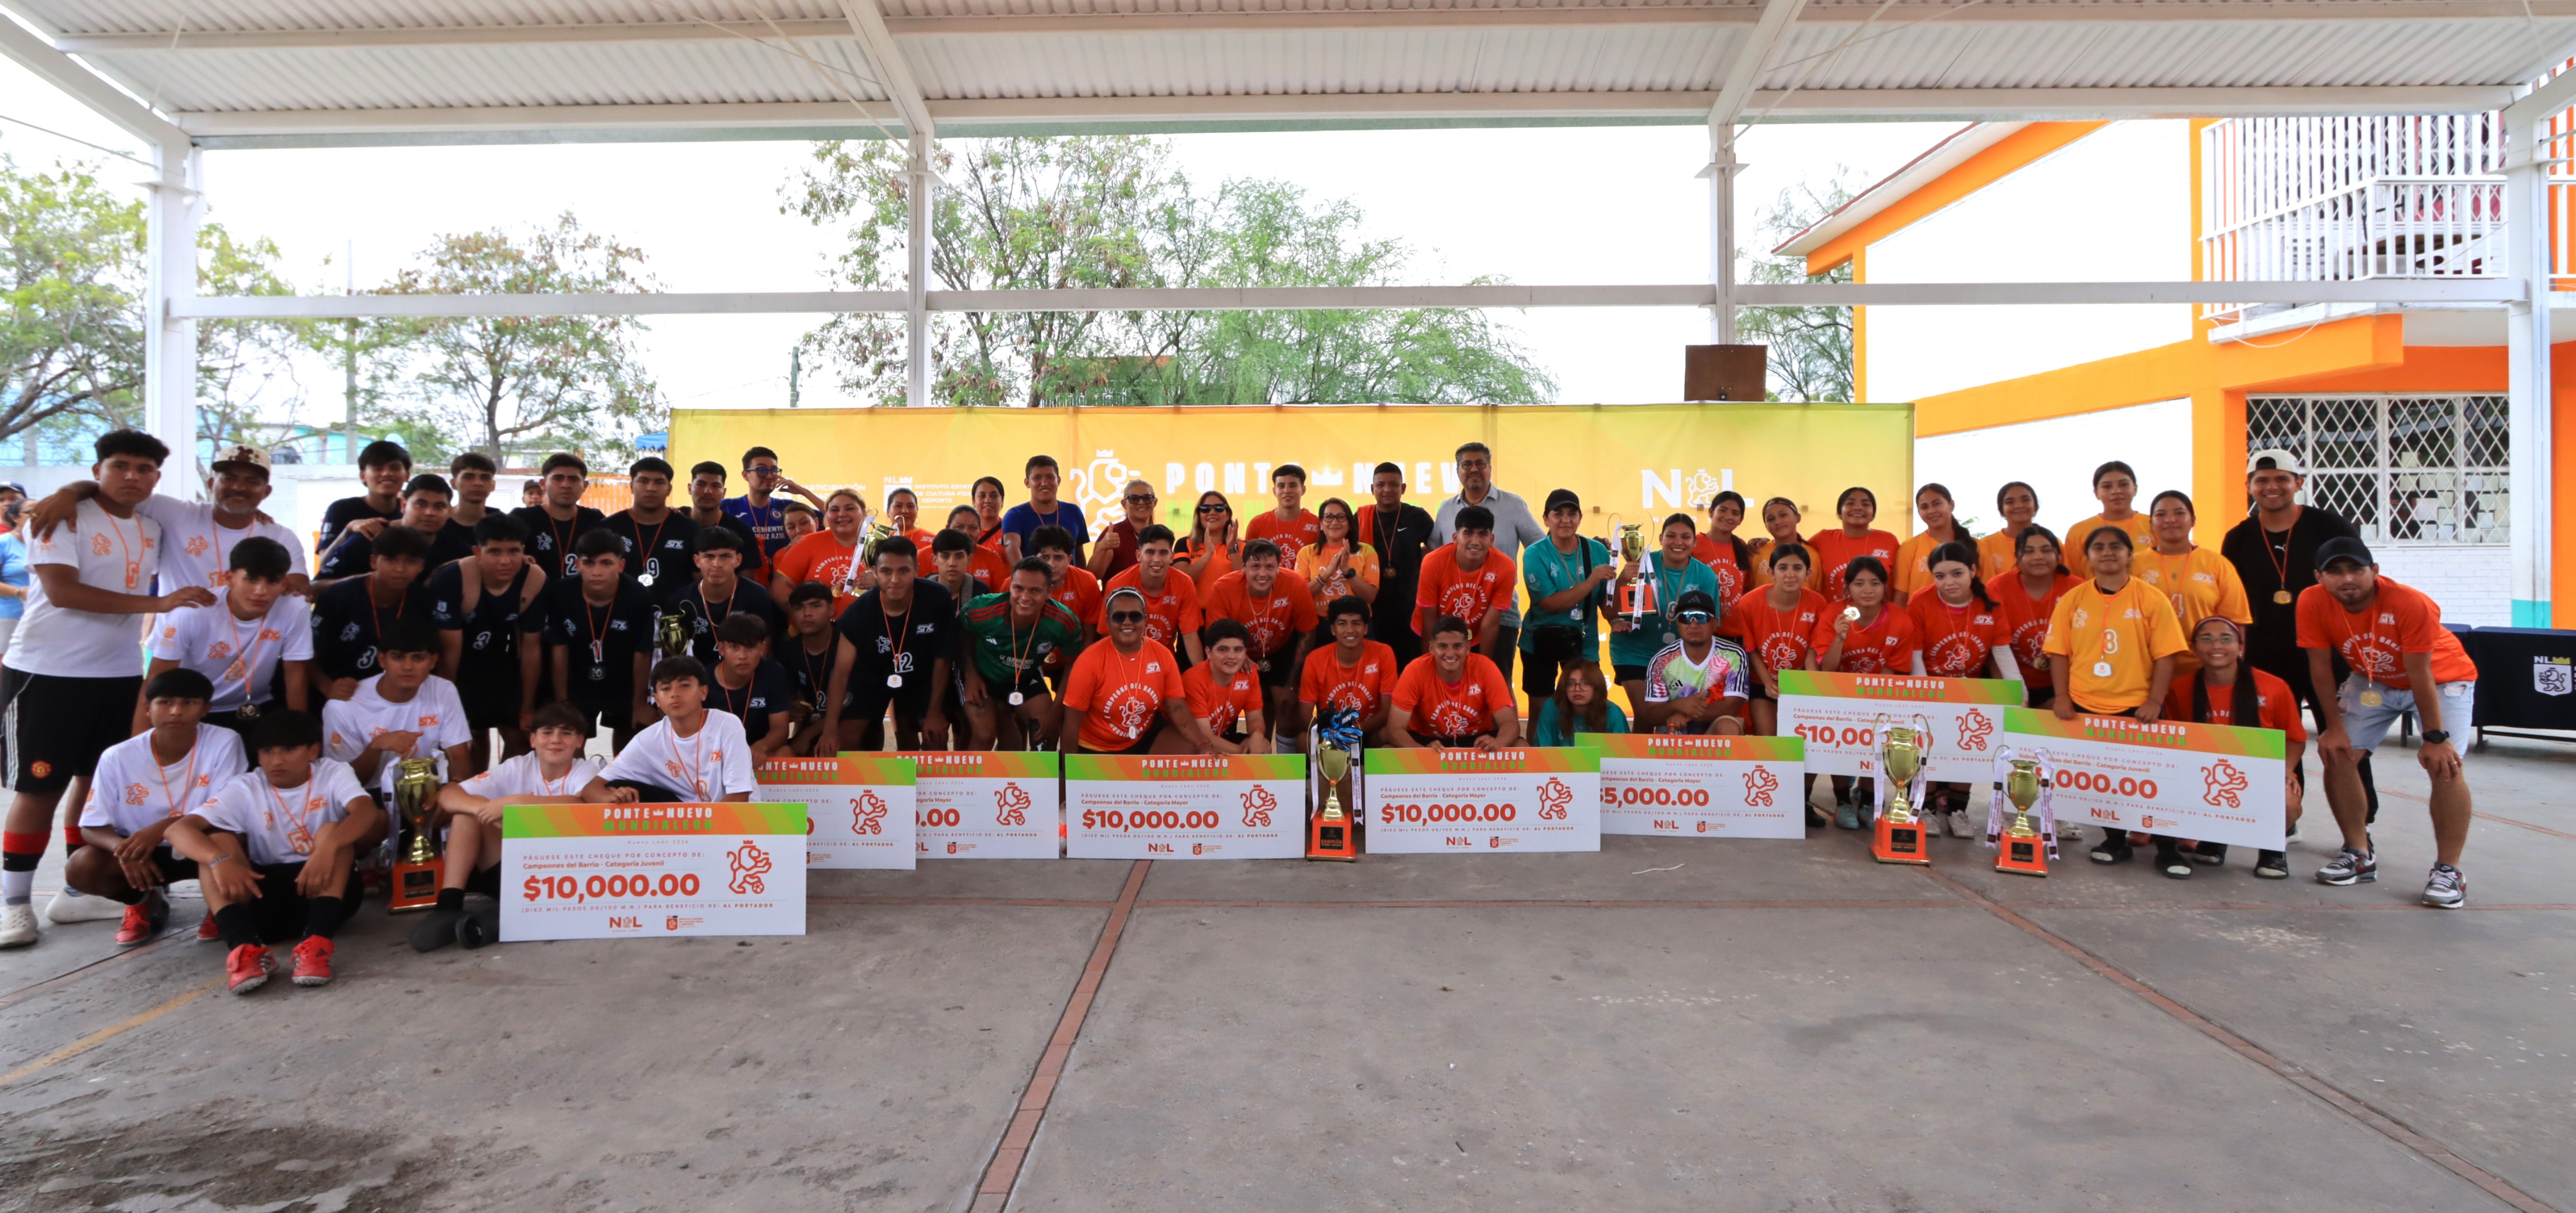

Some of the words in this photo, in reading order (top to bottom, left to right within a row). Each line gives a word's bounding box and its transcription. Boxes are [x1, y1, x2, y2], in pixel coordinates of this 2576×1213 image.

[2103, 629, 2118, 655] 8
[1856, 677, 1893, 687] PONTE
[1907, 680, 1944, 689] NUEVO
[1104, 685, 1128, 713] CAMPEONA
[1143, 685, 1159, 704] BARRIO
[2085, 718, 2125, 730] PONTE
[2141, 721, 2186, 735] NUEVO
[1648, 738, 1682, 747] PONTE
[1695, 739, 1730, 747] NUEVO
[946, 756, 982, 764] NUEVO
[1440, 752, 1475, 760] PONTE
[1489, 752, 1525, 760] NUEVO
[801, 762, 838, 770] NUEVO
[1142, 760, 1177, 768] PONTE
[1191, 759, 1228, 767] NUEVO
[2120, 759, 2162, 769] CONCEPTO
[2128, 765, 2150, 773] Juvenil
[604, 808, 649, 819] PONTE
[667, 808, 712, 818] NUEVO
[1382, 804, 1516, 826] $10,000.00
[1083, 809, 1219, 832] $10,000.00
[524, 874, 700, 904] $10,000.00
